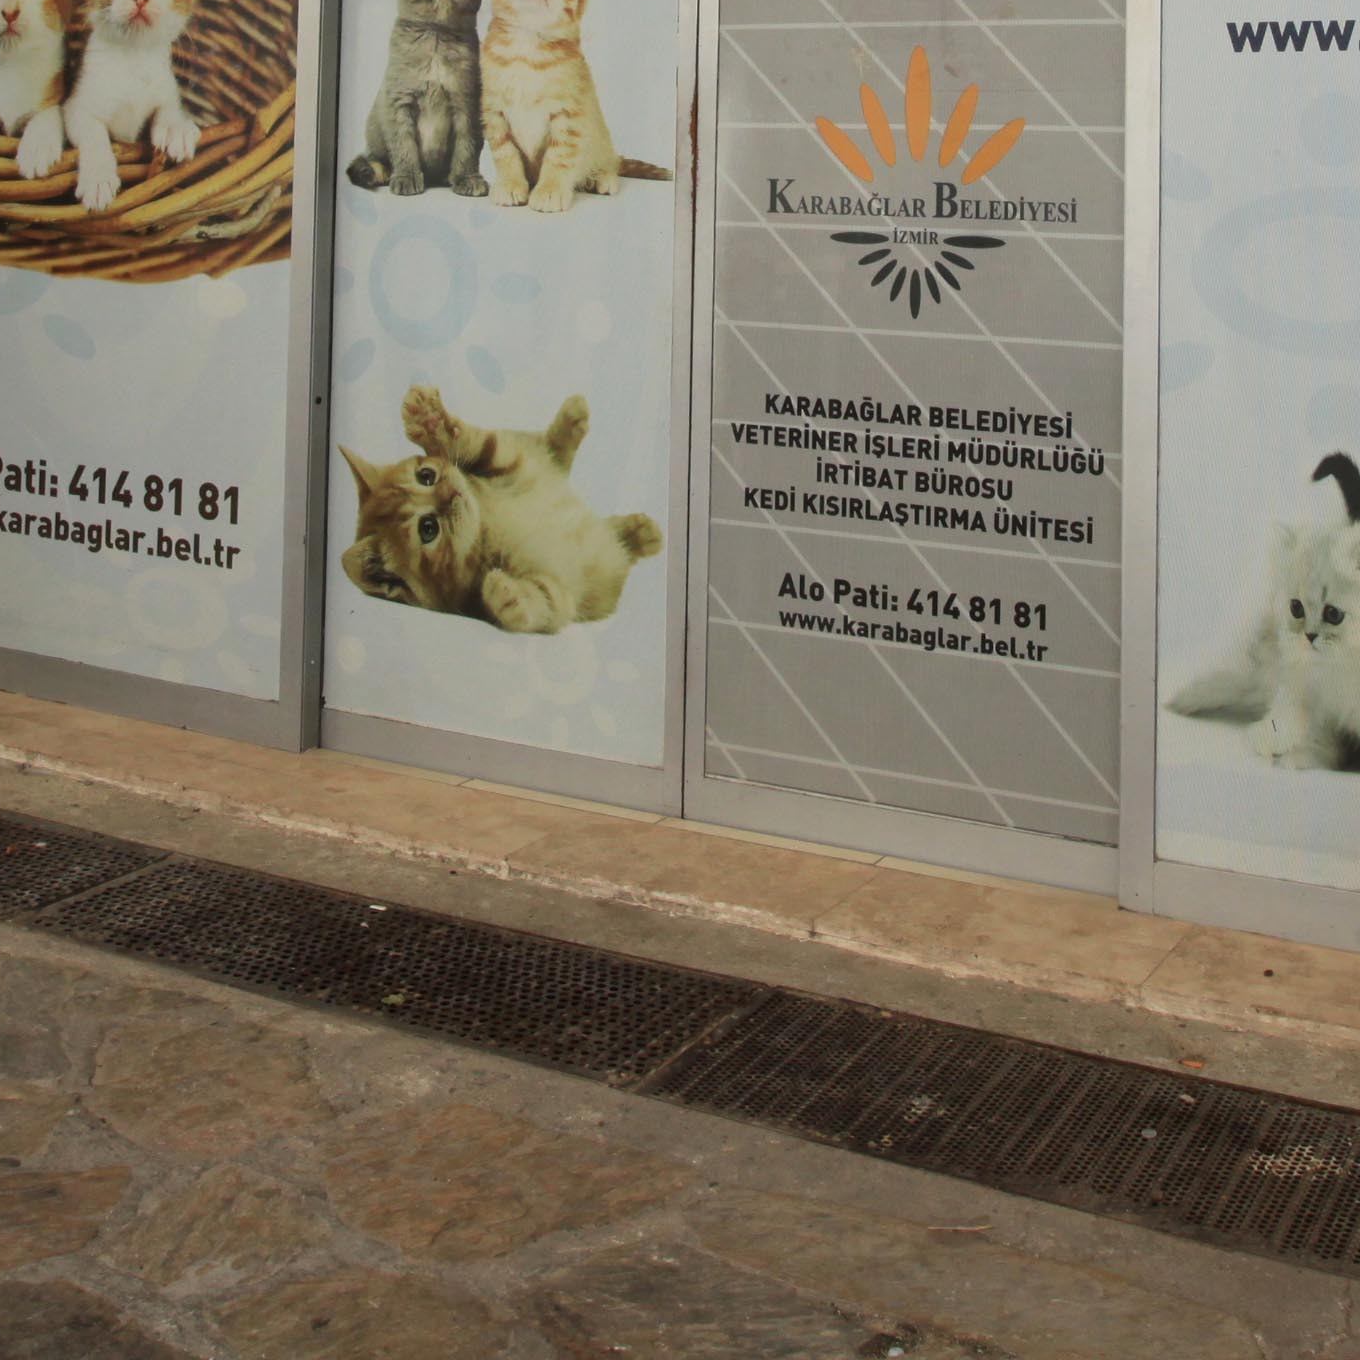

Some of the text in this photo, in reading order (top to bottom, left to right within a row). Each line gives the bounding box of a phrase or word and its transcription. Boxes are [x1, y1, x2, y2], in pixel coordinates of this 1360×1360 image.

[767, 178, 1078, 223] KARABAĞLAR BELEDİYESİ
[893, 227, 939, 245] İZMİR
[765, 394, 1073, 439] KARABAĞLAR BELEDİYESİ
[731, 422, 1104, 476] VETERİNER İŞLERİ MÜDÜRLÜĞÜ
[68, 464, 133, 508] 414
[143, 474, 183, 516] 81
[198, 482, 239, 525] 81
[816, 457, 1013, 501] İRTİBAT BÜROSU
[744, 486, 1094, 545] KEDİ KISIRLAŞTIRMA ÜNİTESİ
[778, 573, 1047, 631] Alo Pati: 414 81 81
[779, 610, 1049, 662] www.karabaglar.bel.tr
